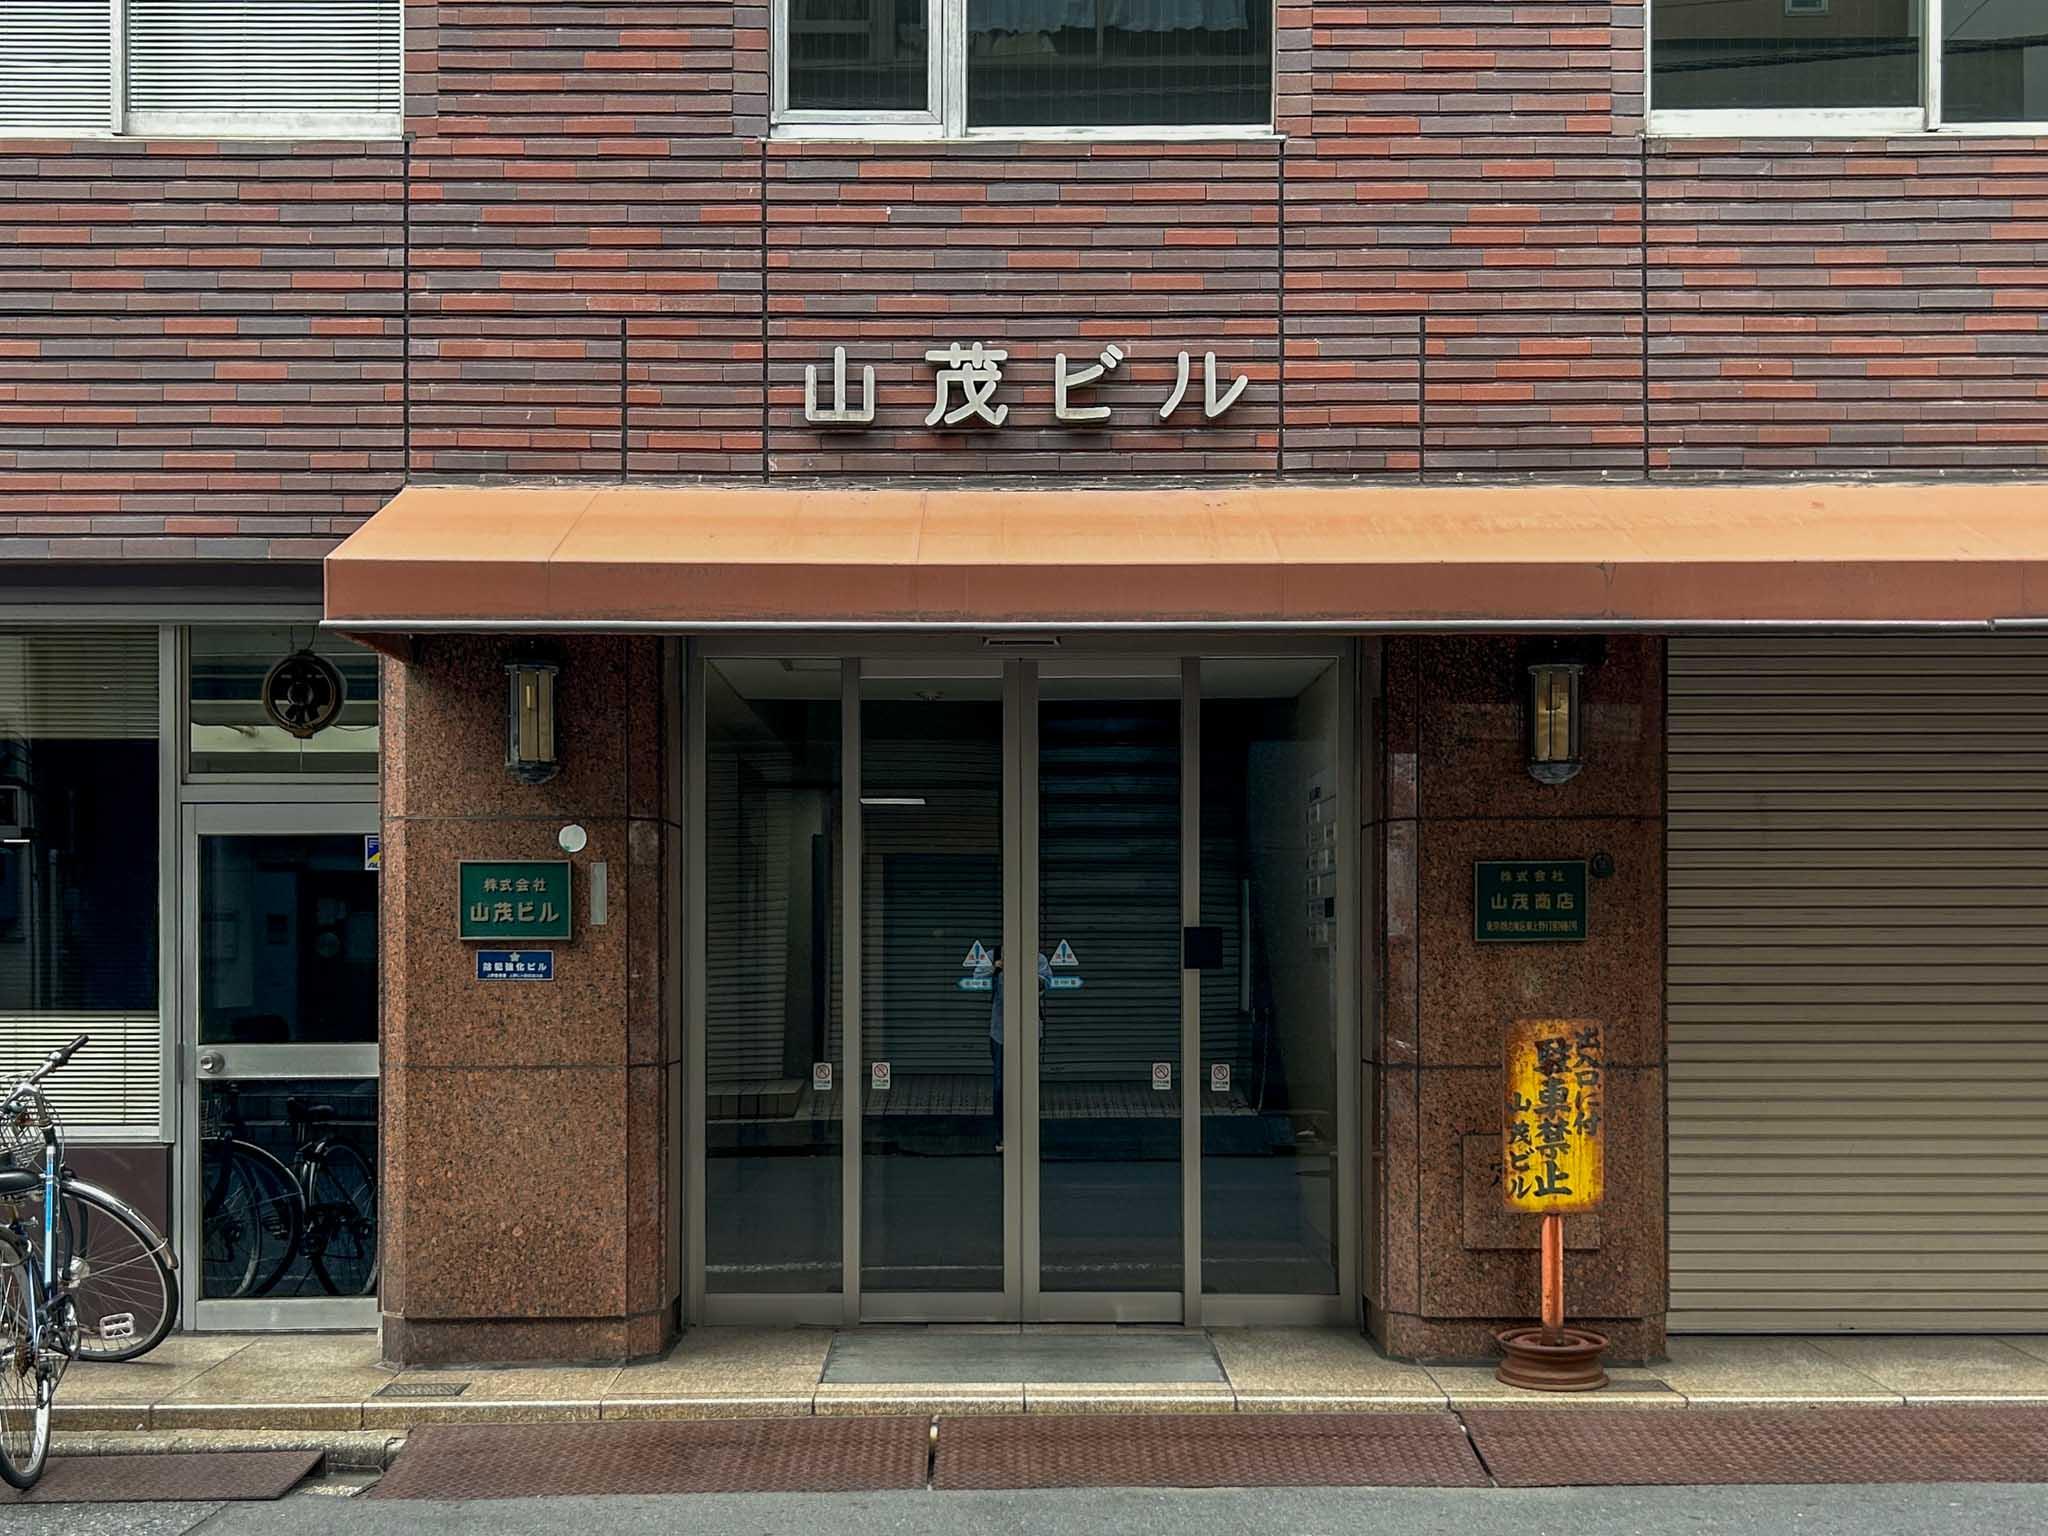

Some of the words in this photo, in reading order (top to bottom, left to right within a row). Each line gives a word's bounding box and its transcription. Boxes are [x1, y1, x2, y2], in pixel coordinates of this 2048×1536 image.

[805, 342, 1248, 426] 山茂ビル
[484, 878, 547, 892] 株式会社
[1490, 892, 1575, 910] 山茂商店
[469, 901, 560, 923] 山茂ビル
[1533, 1036, 1574, 1198] 駐車禁止
[1506, 1091, 1535, 1199] 山茂ビル
